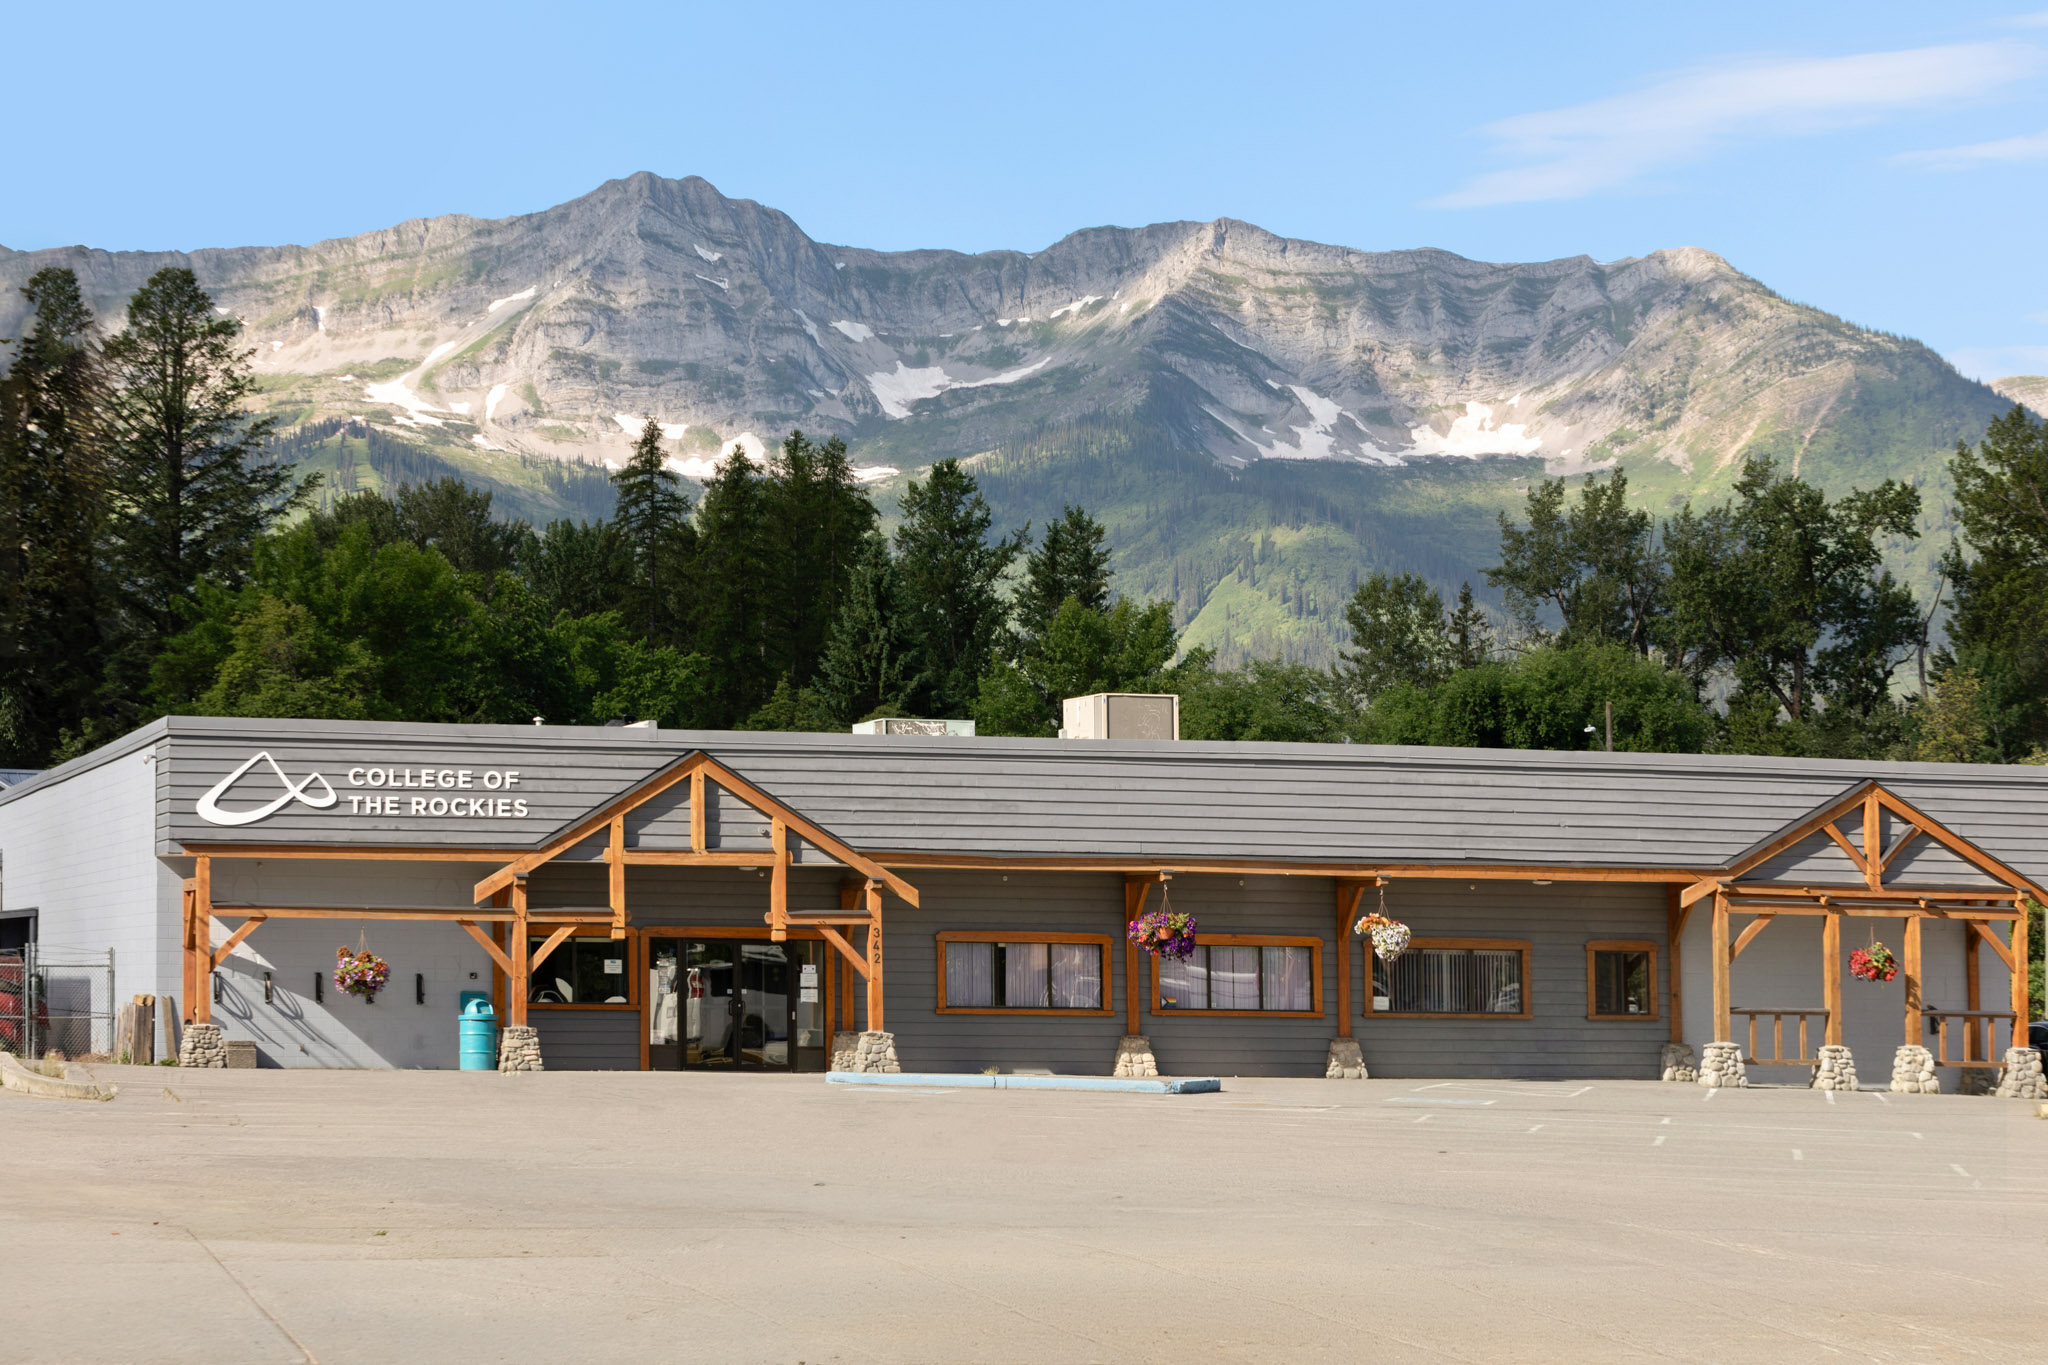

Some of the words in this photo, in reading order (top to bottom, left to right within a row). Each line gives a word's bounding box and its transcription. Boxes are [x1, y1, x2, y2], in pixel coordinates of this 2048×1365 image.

[348, 767, 473, 788] COLLEGE
[483, 770, 520, 789] OF
[348, 795, 400, 815] THE
[411, 797, 529, 817] ROCKIES
[873, 927, 881, 964] 342
